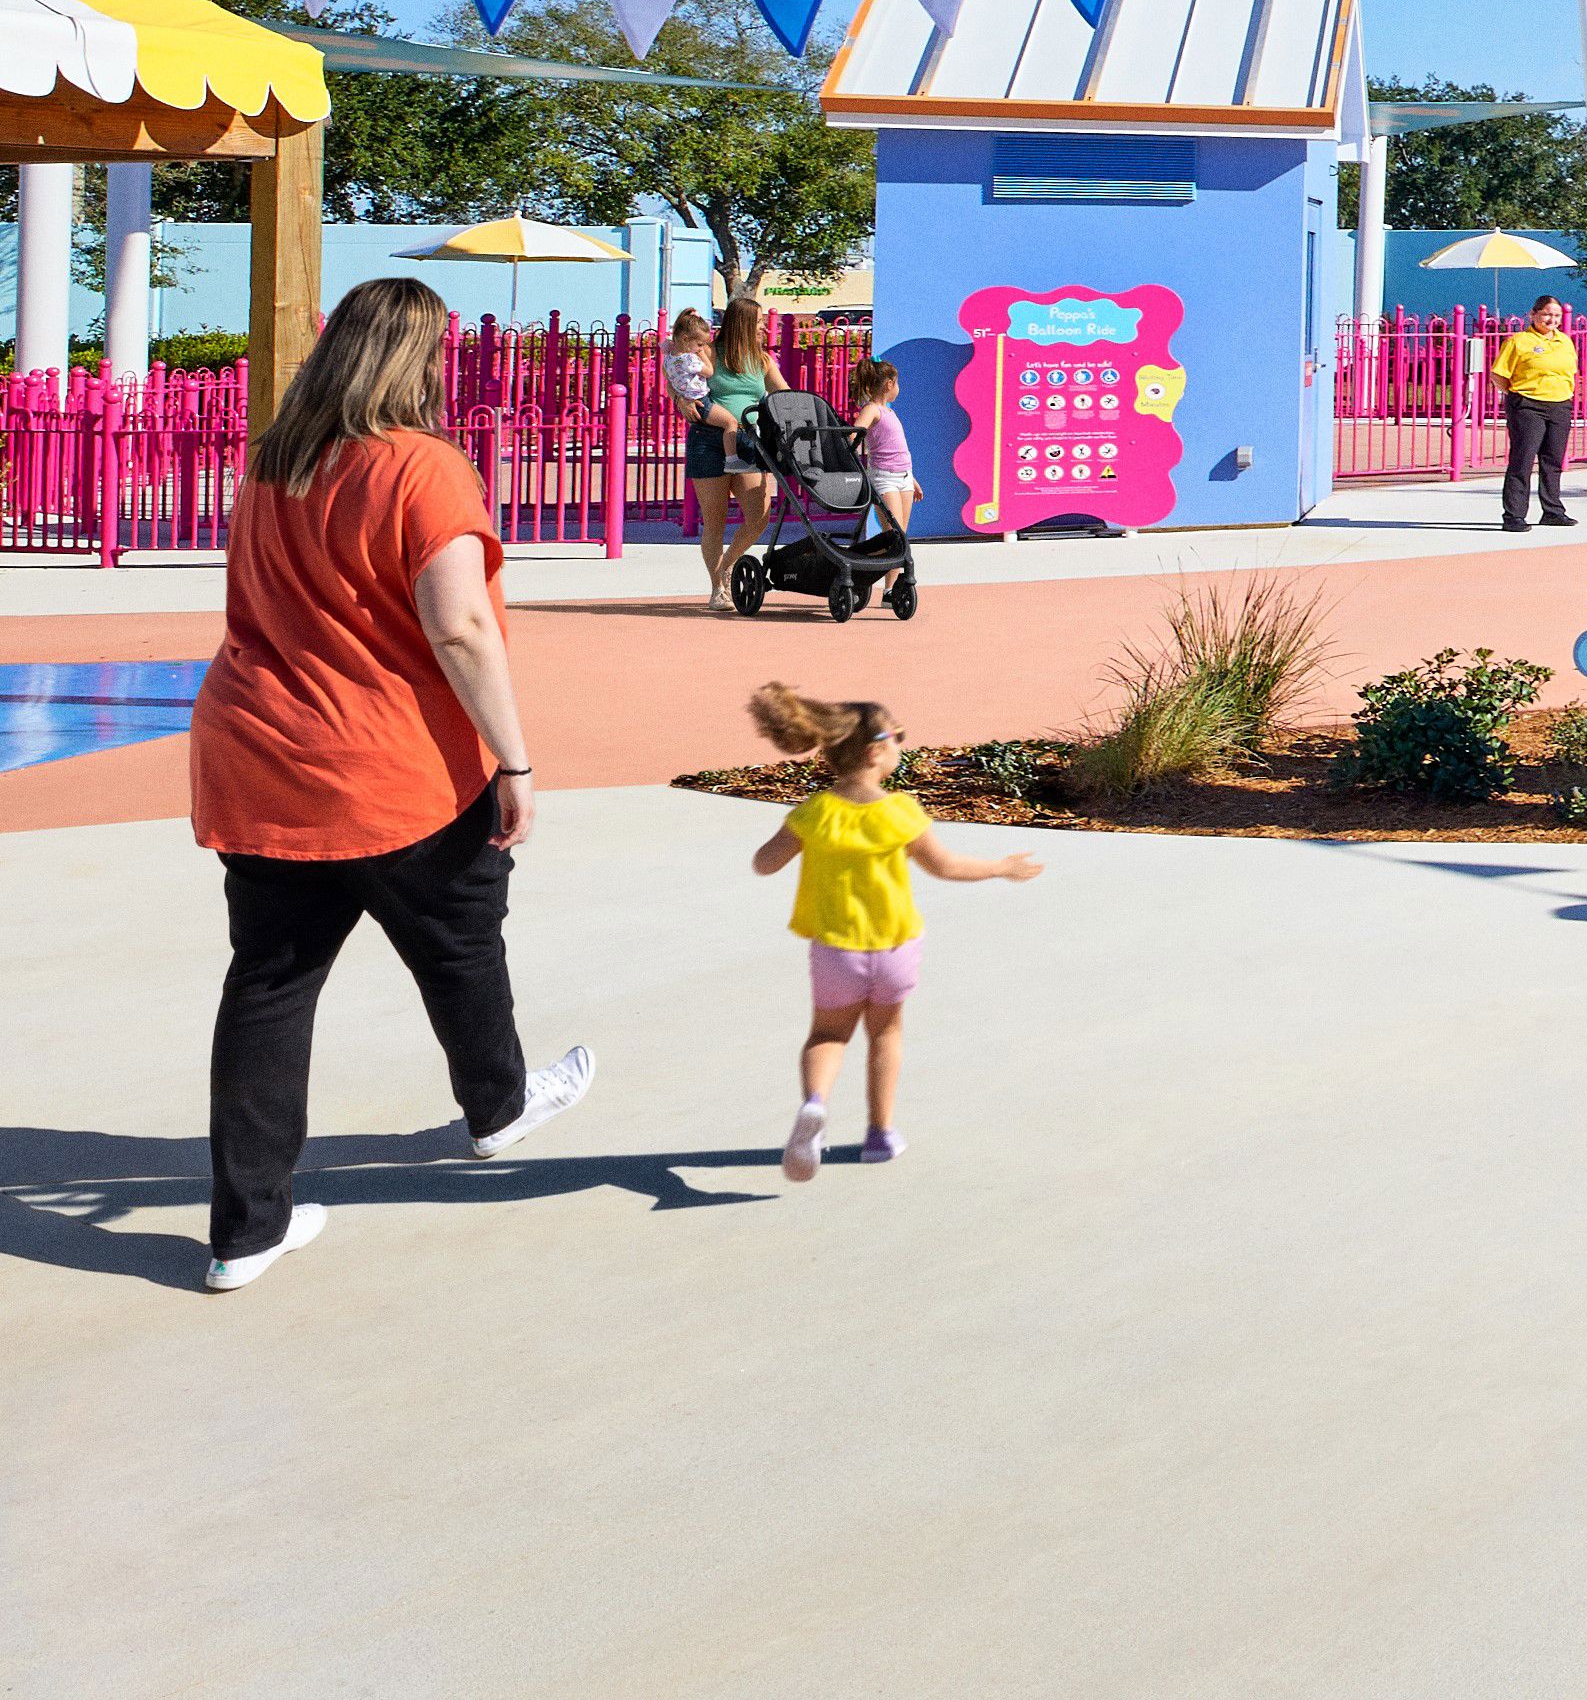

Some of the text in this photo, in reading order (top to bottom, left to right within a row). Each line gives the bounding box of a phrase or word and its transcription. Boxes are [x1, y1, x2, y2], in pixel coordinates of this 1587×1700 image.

[1048, 306, 1097, 323] Peppa's
[1027, 322, 1117, 337] Balloon Ride
